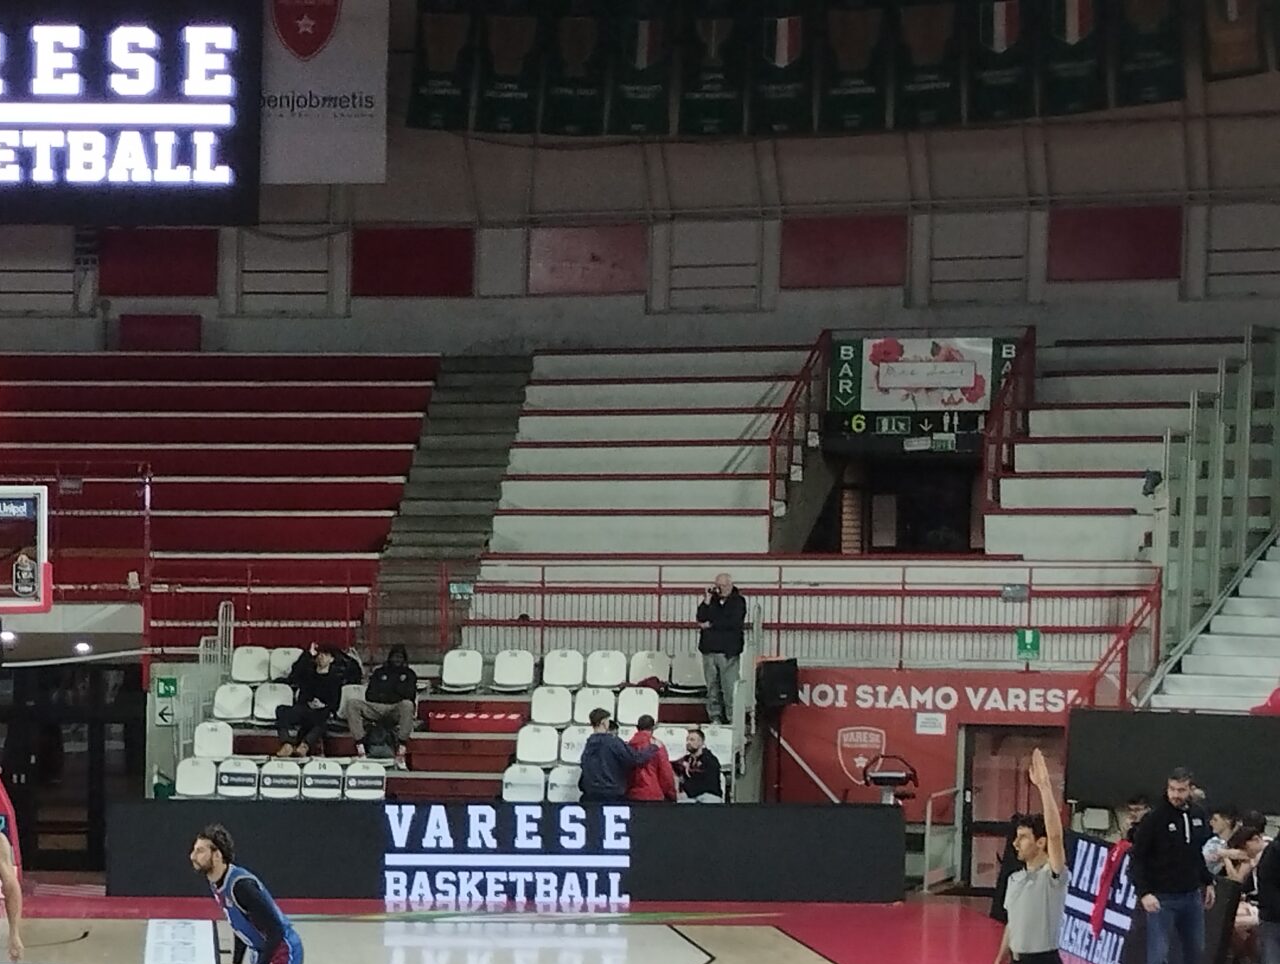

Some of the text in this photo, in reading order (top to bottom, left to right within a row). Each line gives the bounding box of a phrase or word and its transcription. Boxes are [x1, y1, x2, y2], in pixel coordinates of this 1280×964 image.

[838, 346, 855, 394] BAR
[855, 684, 959, 710] SIAMO
[384, 804, 631, 850] VARESE
[384, 870, 630, 903] BASKETBALL
